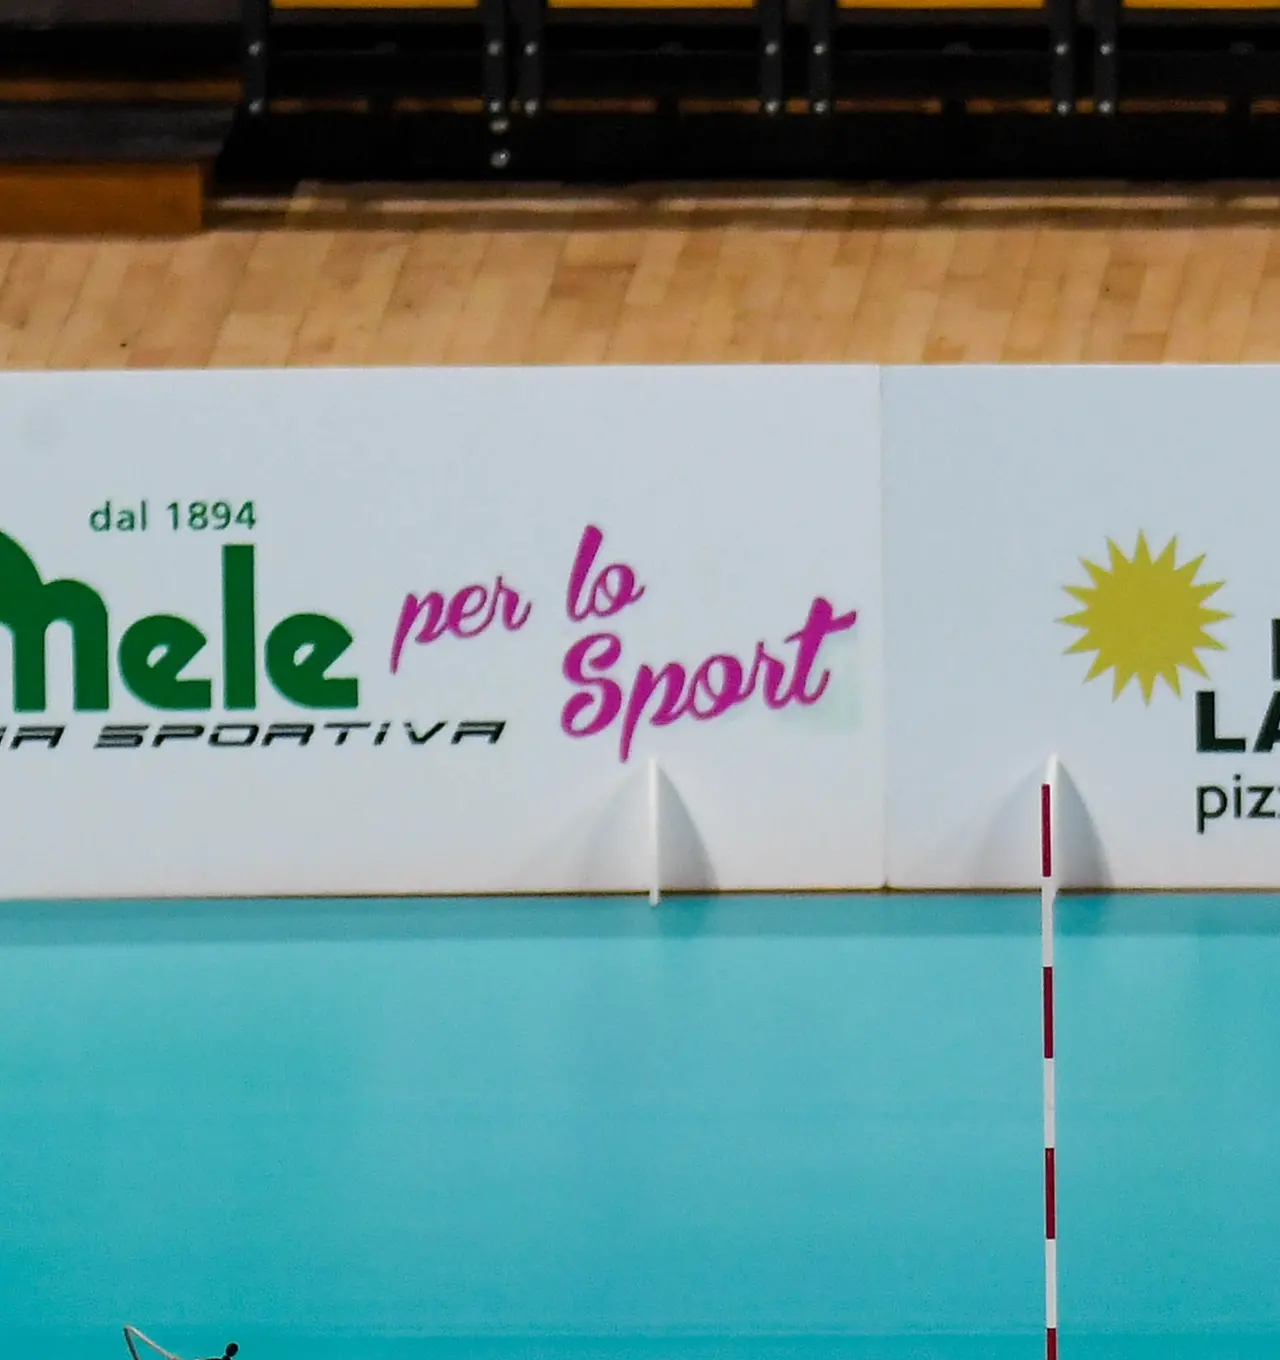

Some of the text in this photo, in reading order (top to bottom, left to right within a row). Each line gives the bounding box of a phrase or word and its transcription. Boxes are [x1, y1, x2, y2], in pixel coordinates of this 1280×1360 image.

[89, 499, 257, 532] dal 1894
[390, 524, 645, 675] per lo
[560, 596, 858, 763] Sport
